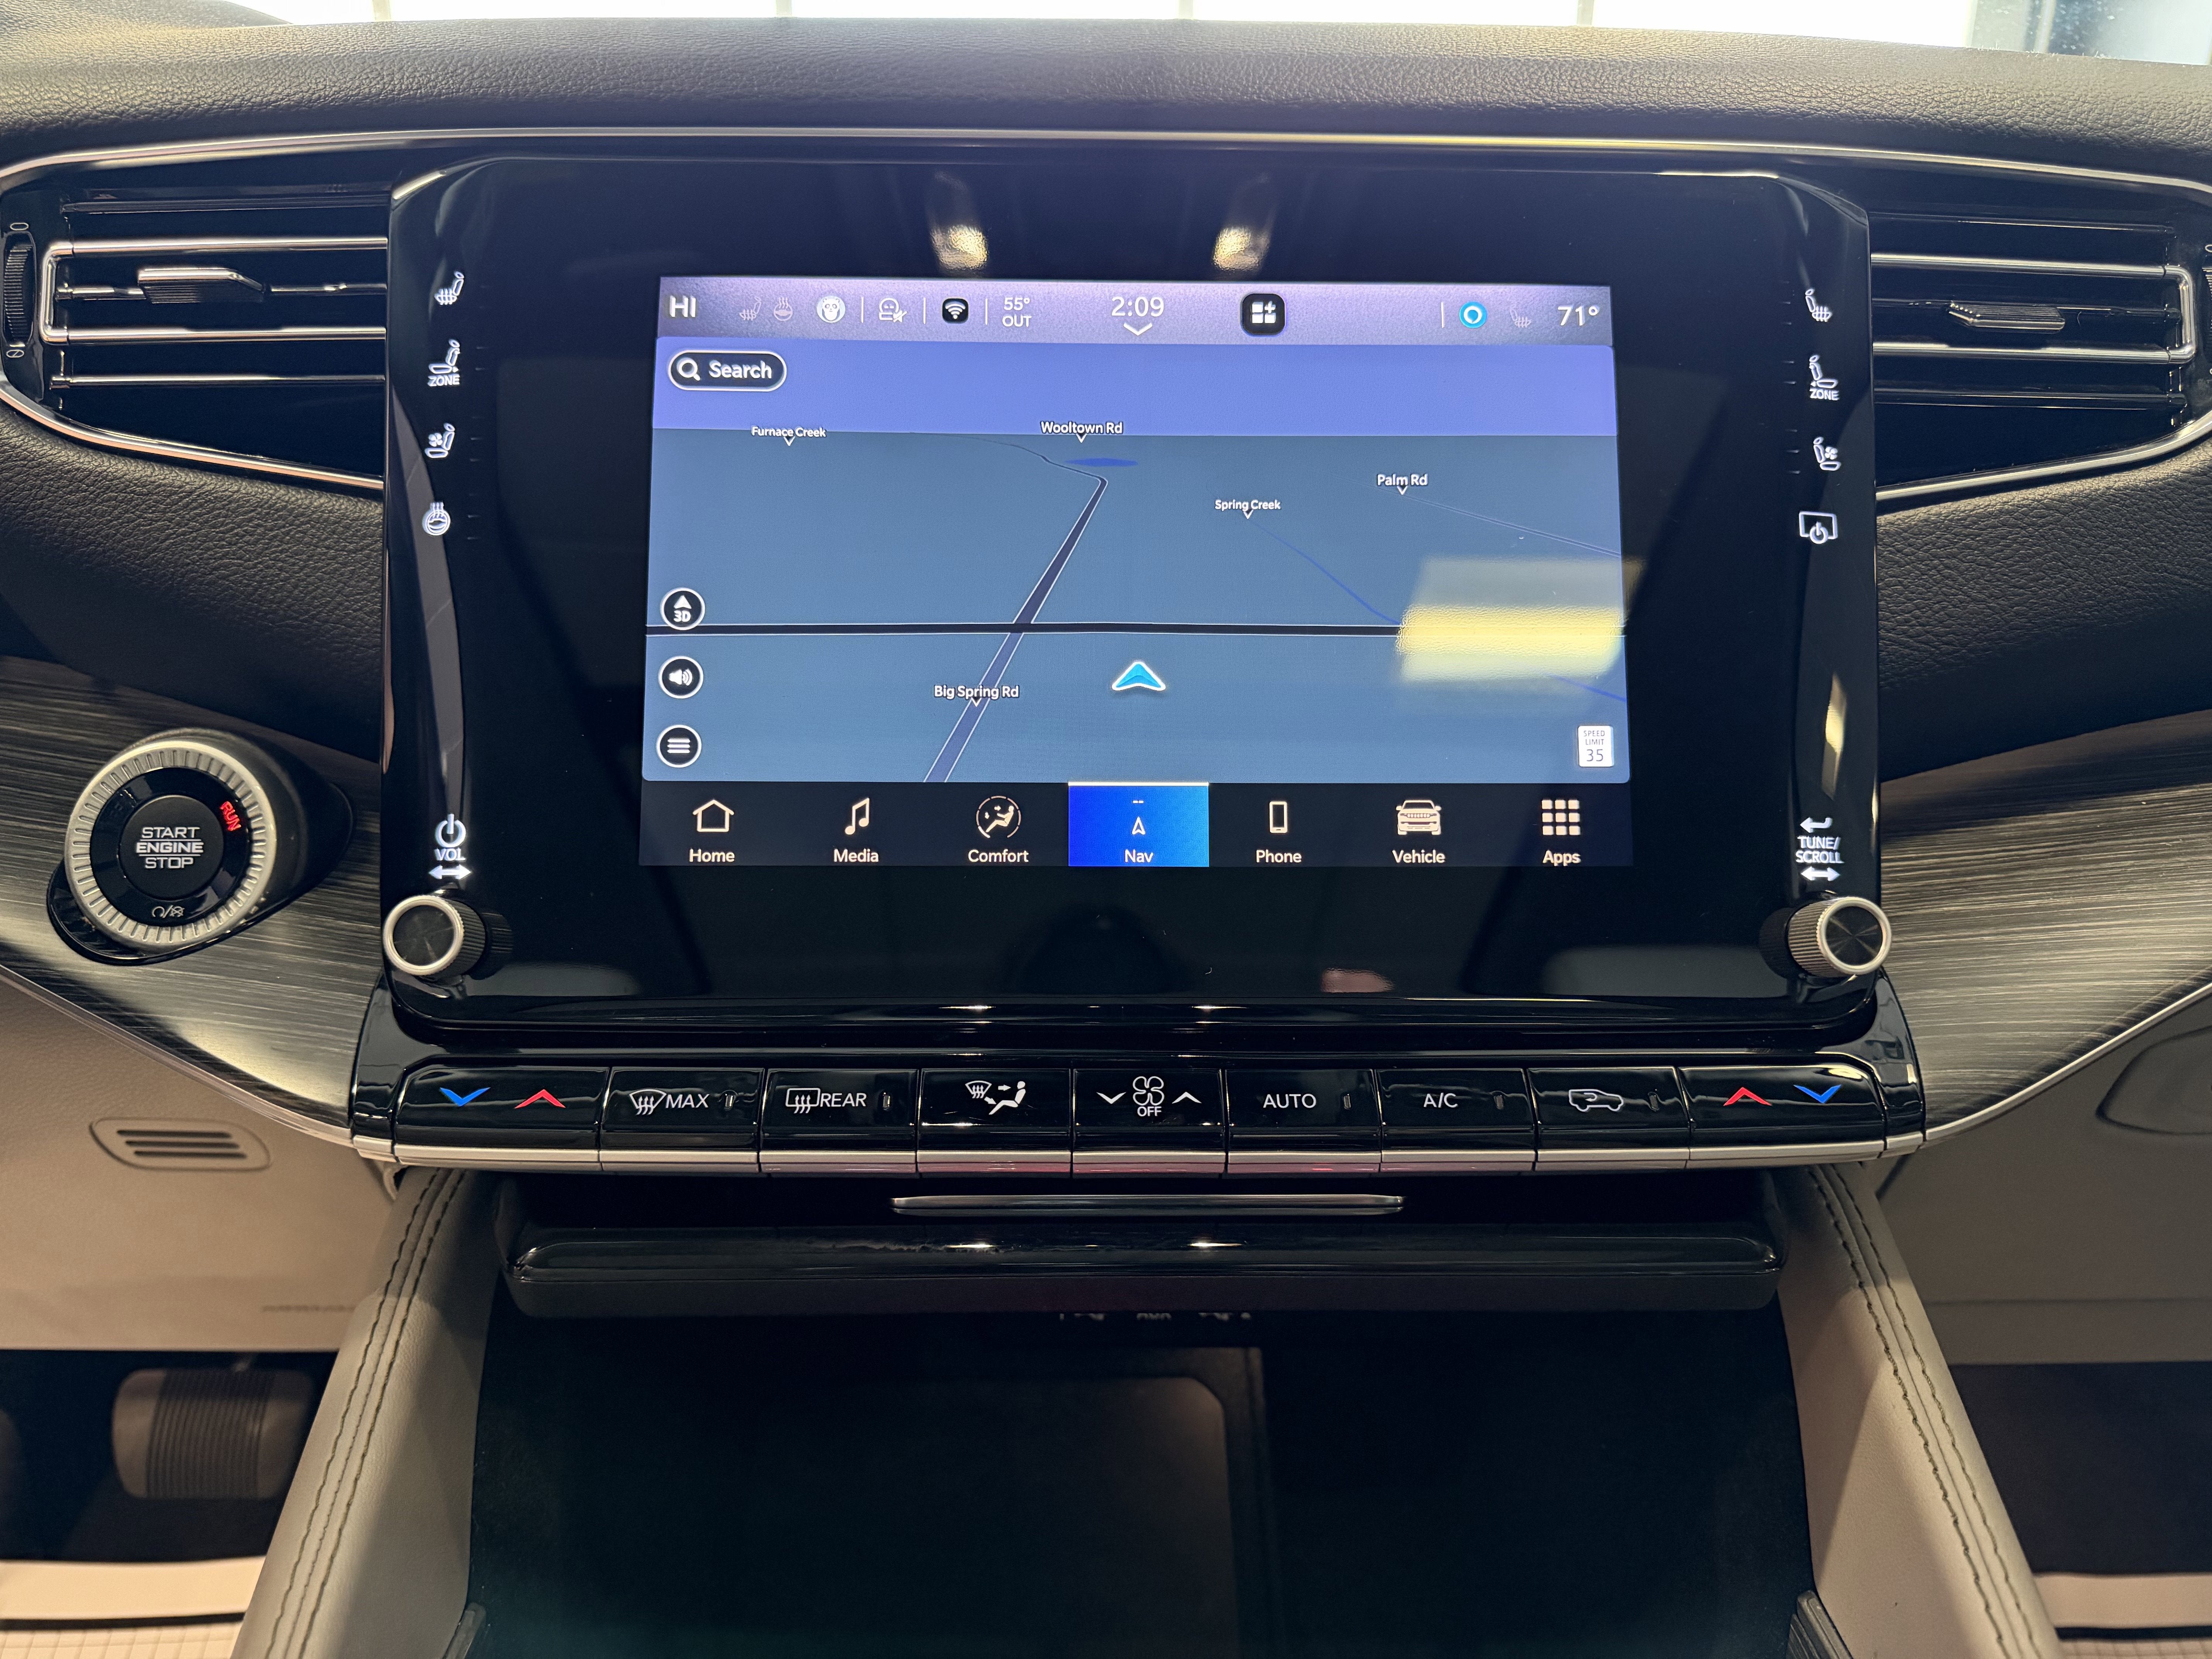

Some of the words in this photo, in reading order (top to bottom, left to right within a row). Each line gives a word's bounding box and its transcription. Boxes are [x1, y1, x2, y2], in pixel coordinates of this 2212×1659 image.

[670, 297, 696, 318] HI
[1004, 297, 1030, 311] 55°
[1111, 297, 1164, 318] 2:09
[1002, 316, 1032, 327] OUT
[1558, 305, 1599, 325] 71°
[709, 361, 772, 379] Search
[428, 374, 460, 386] ZONE
[1810, 388, 1839, 400] ZONE
[752, 426, 793, 436] Furnace
[795, 427, 826, 437] Creek
[1041, 421, 1103, 433] Wooltown
[1106, 422, 1123, 433] Rd
[1377, 474, 1407, 485] Palm
[1410, 474, 1428, 485] Rd
[1215, 500, 1249, 511] Spring
[1251, 500, 1280, 510] Creek
[674, 610, 691, 622] 3D
[934, 686, 954, 699] Big
[958, 686, 999, 699] Spring
[1002, 686, 1018, 698] Rd
[1587, 749, 1603, 761] 35
[221, 801, 240, 831] RUN
[142, 827, 199, 838] START
[136, 842, 204, 853] ENGINE
[1797, 836, 1841, 850] TUNE/
[434, 848, 465, 860] VOL
[689, 849, 735, 862] Home
[834, 849, 879, 862] Media
[968, 849, 1029, 862] Comfort
[1125, 849, 1154, 862] Nav
[1256, 850, 1302, 863] Phone
[1393, 850, 1445, 863] Vehicle
[1543, 850, 1580, 866] Apps
[1795, 851, 1844, 863] SCROLL
[145, 858, 193, 869] STOP
[666, 1093, 709, 1109] MAX
[820, 1093, 866, 1108] REAR
[1263, 1094, 1316, 1109] AUTO
[1423, 1093, 1458, 1108] A/C
[1137, 1106, 1162, 1117] OFF
